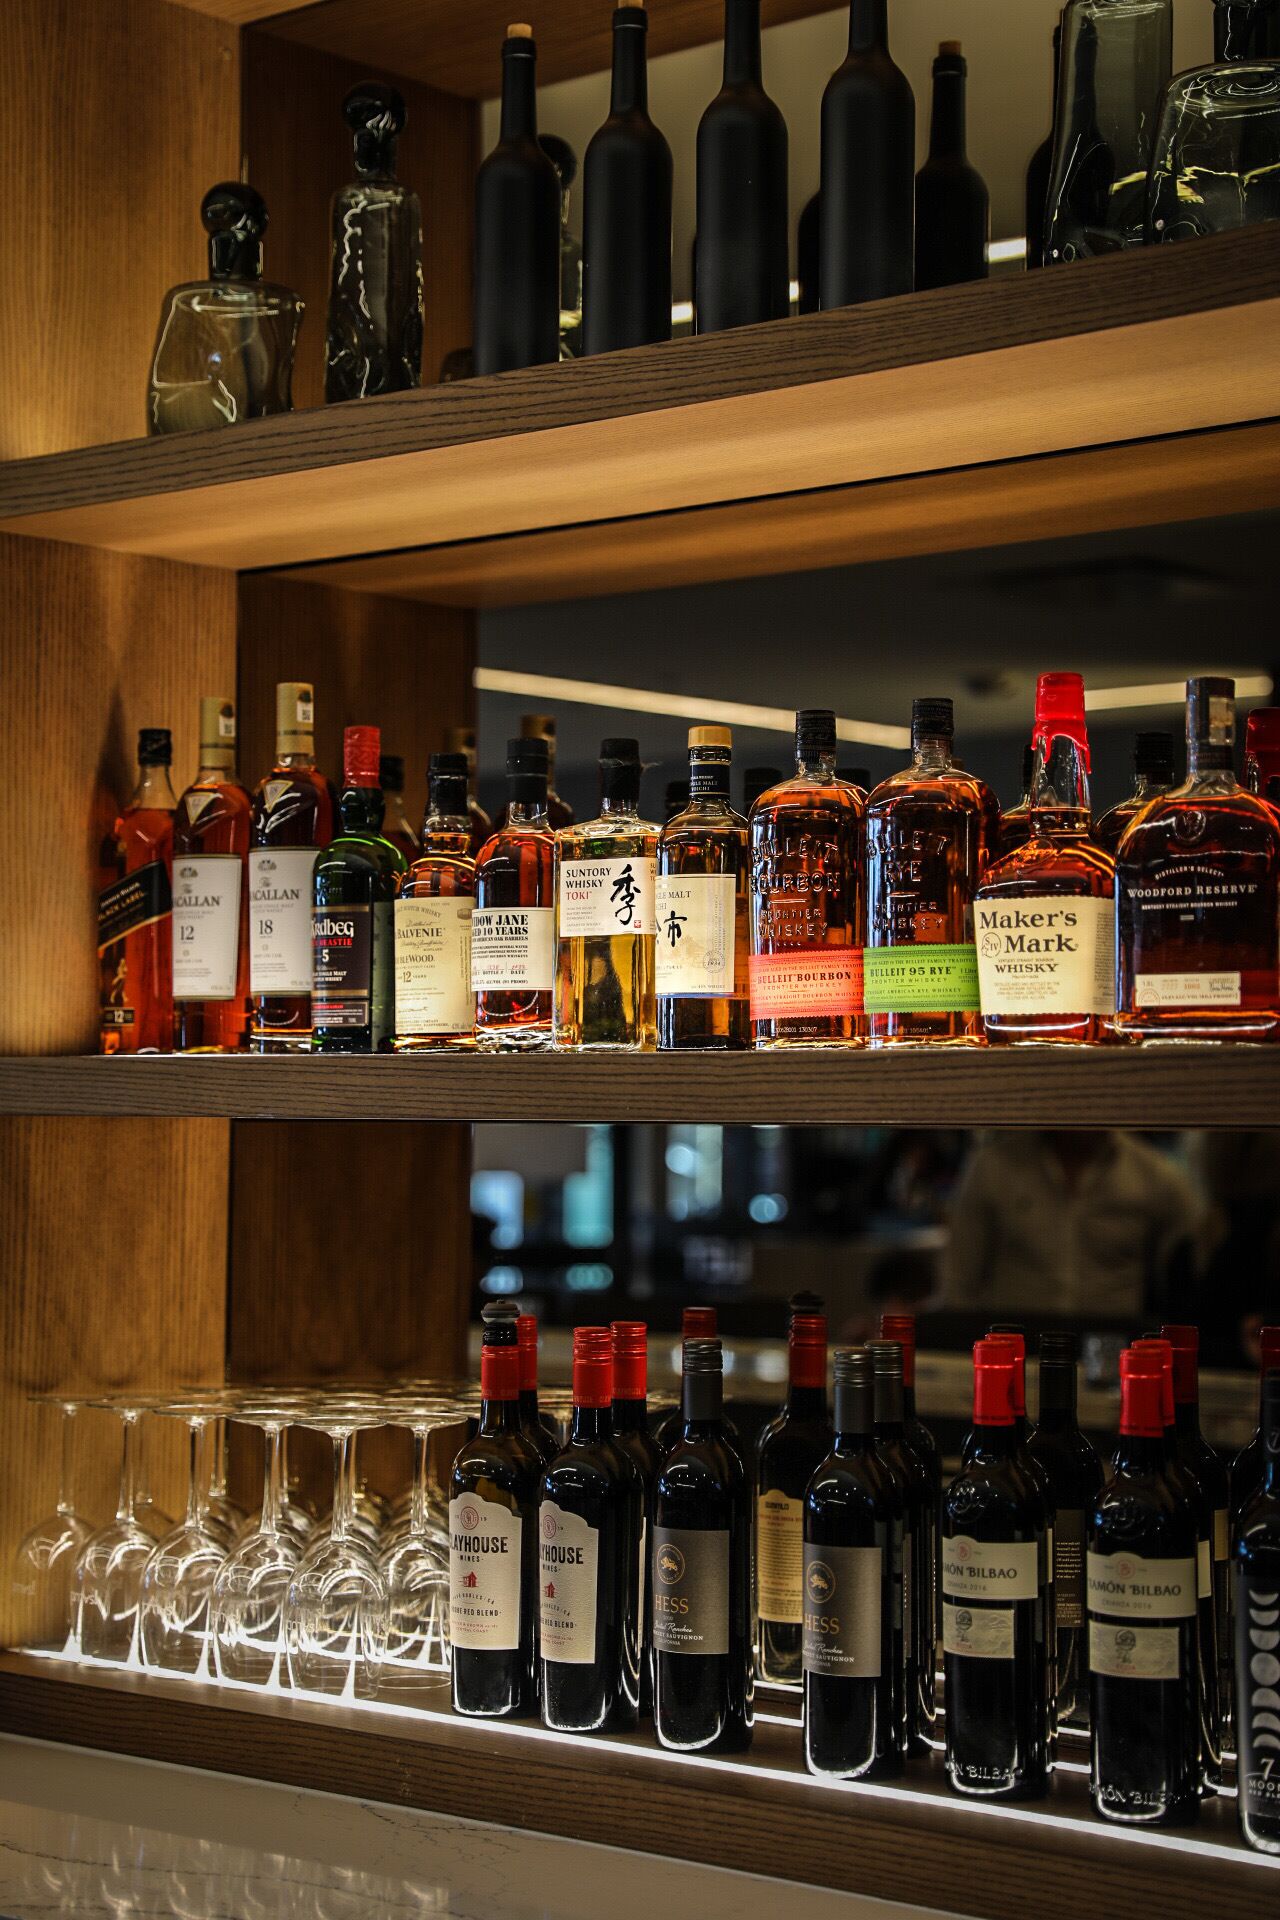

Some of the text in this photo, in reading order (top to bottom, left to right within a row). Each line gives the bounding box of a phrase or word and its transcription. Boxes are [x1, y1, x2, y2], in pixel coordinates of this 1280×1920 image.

[566, 867, 611, 878] SUNTORY
[884, 861, 922, 882] RYE
[1154, 865, 1195, 880] DISTILLER'S
[1197, 866, 1222, 876] SELECT
[566, 879, 604, 889] WHISKY
[566, 891, 589, 900] TOKI
[609, 863, 641, 926] 季
[668, 890, 691, 899] MALT
[1127, 884, 1256, 898] WOODFORD RESERVE
[173, 896, 220, 908] CALLAN
[875, 901, 937, 913] FRONTIER
[421, 906, 441, 918] WHISKY
[760, 908, 822, 920] FRONTIER
[472, 914, 529, 927] IDOW JANE
[979, 910, 1078, 929] Maker's
[180, 925, 195, 941] 12
[258, 919, 274, 936] 18
[396, 927, 443, 938] BALVENIE
[484, 928, 493, 936] 10
[495, 926, 528, 936] YEARS
[759, 922, 828, 937] WHISKEY
[319, 938, 353, 946] BEASTIE
[1004, 933, 1078, 954] Mark
[322, 949, 330, 962] 5
[870, 966, 951, 977] BULLEIT 95 RYE
[994, 963, 1060, 973] WHISKY
[402, 971, 411, 983] 12
[758, 971, 851, 984] BULLEIT BOURBON
[114, 1010, 125, 1023] 12
[450, 1534, 509, 1554] AYHOUSE
[459, 1555, 480, 1563] WINES
[541, 1543, 584, 1565] YHOUSE
[944, 1562, 1018, 1579] MÓN BILBAO
[1129, 1584, 1182, 1597] BILBAO
[655, 1594, 689, 1614] HESS
[463, 1608, 499, 1617] RED BLEND
[554, 1620, 574, 1629] BLEND
[804, 1613, 840, 1635] HESS
[666, 1633, 704, 1641] SAUVIGNON
[966, 1764, 1015, 1780] BILBA
[1260, 1757, 1276, 1780] 7
